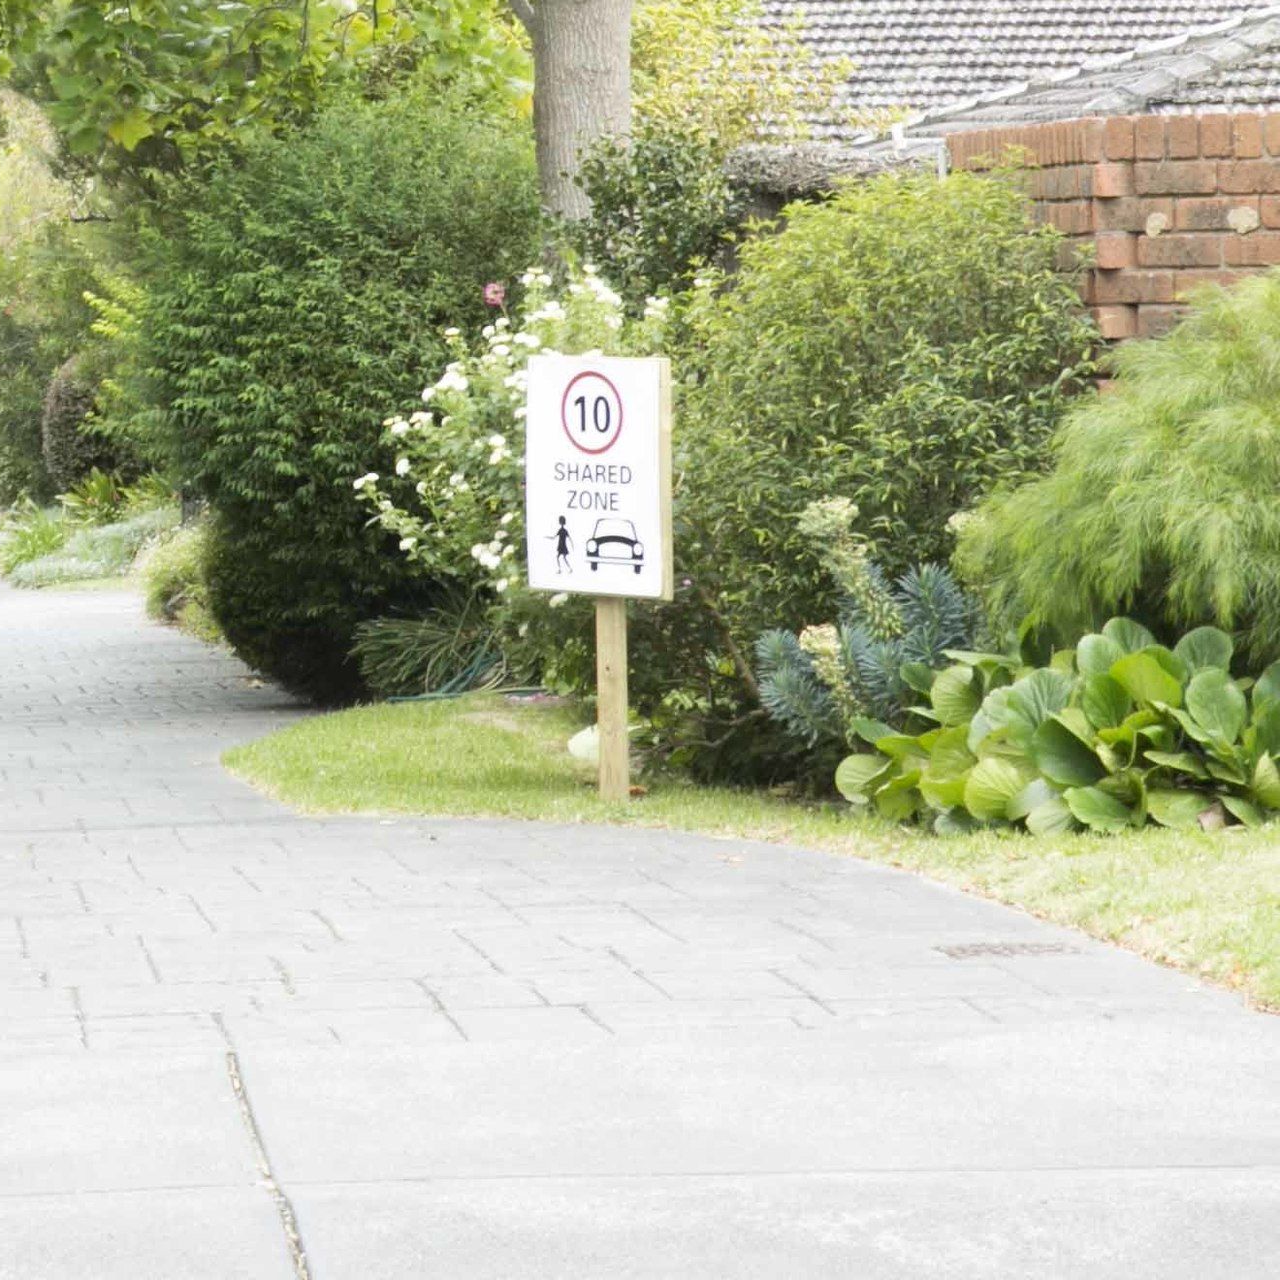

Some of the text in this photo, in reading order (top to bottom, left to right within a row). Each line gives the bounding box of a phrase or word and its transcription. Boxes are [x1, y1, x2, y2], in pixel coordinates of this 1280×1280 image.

[574, 395, 611, 433] 10
[553, 462, 632, 485] SHARED
[566, 489, 620, 511] ZONE
